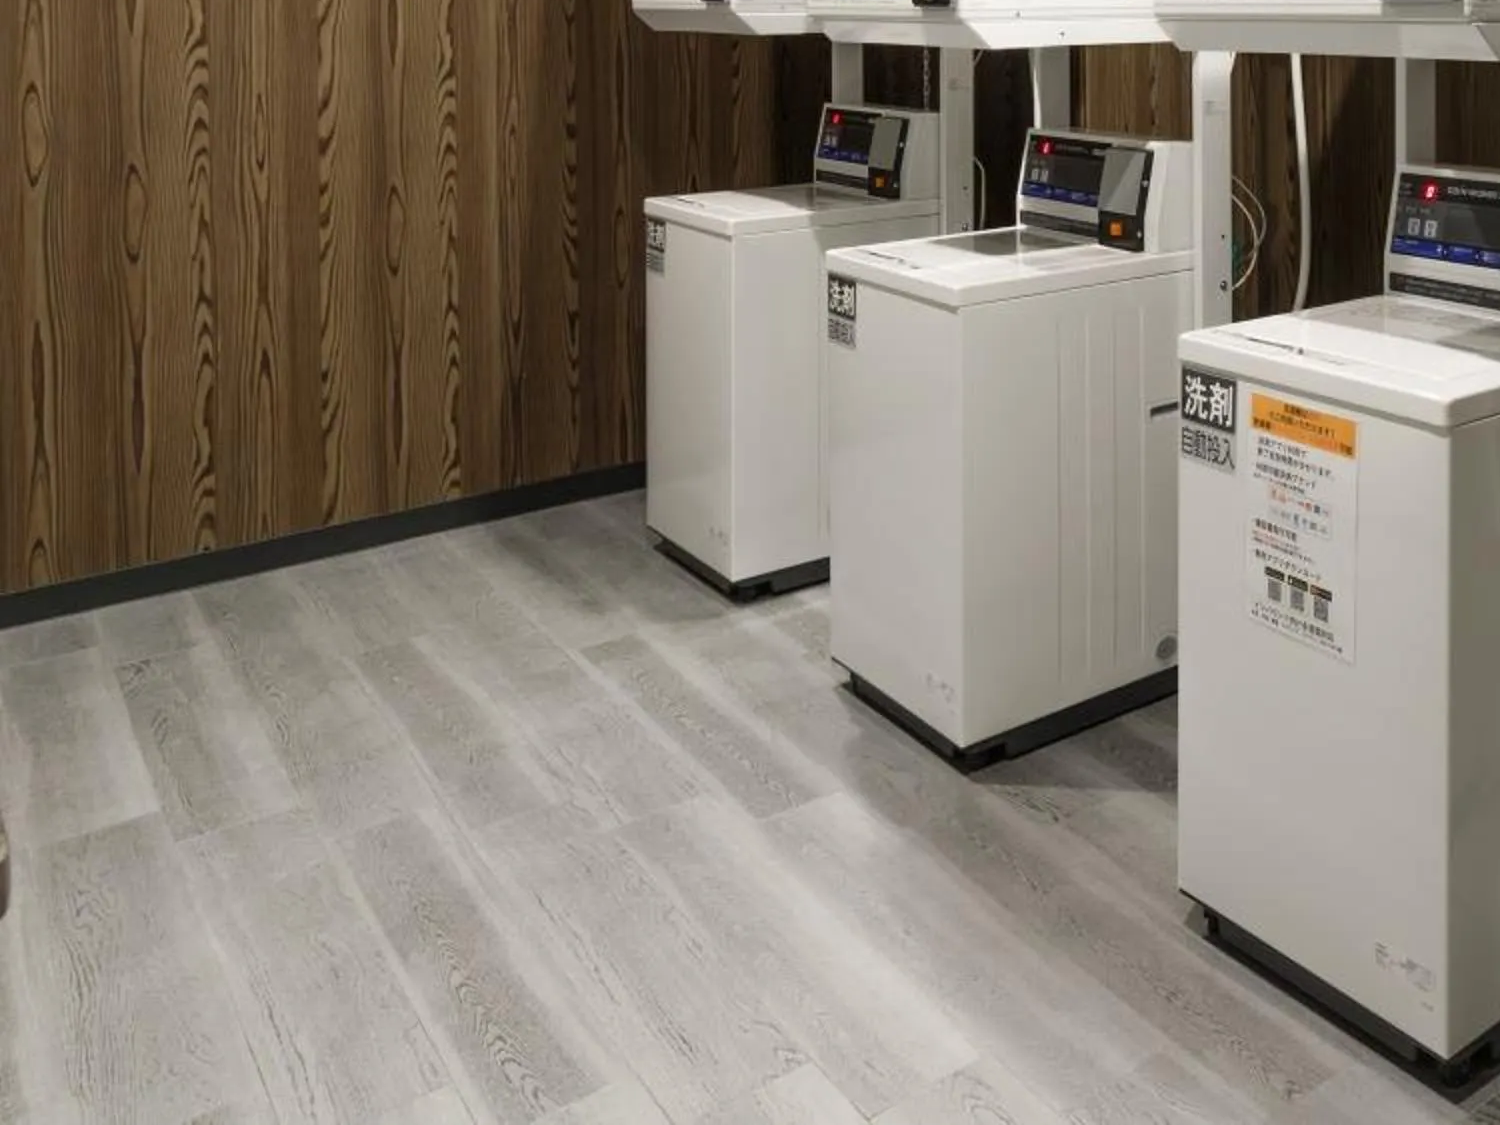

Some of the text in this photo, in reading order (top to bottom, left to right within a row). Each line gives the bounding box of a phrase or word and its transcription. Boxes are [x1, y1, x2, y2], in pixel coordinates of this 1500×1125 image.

[1185, 375, 1234, 428] 洗剤
[1182, 427, 1236, 470] 自動投入
